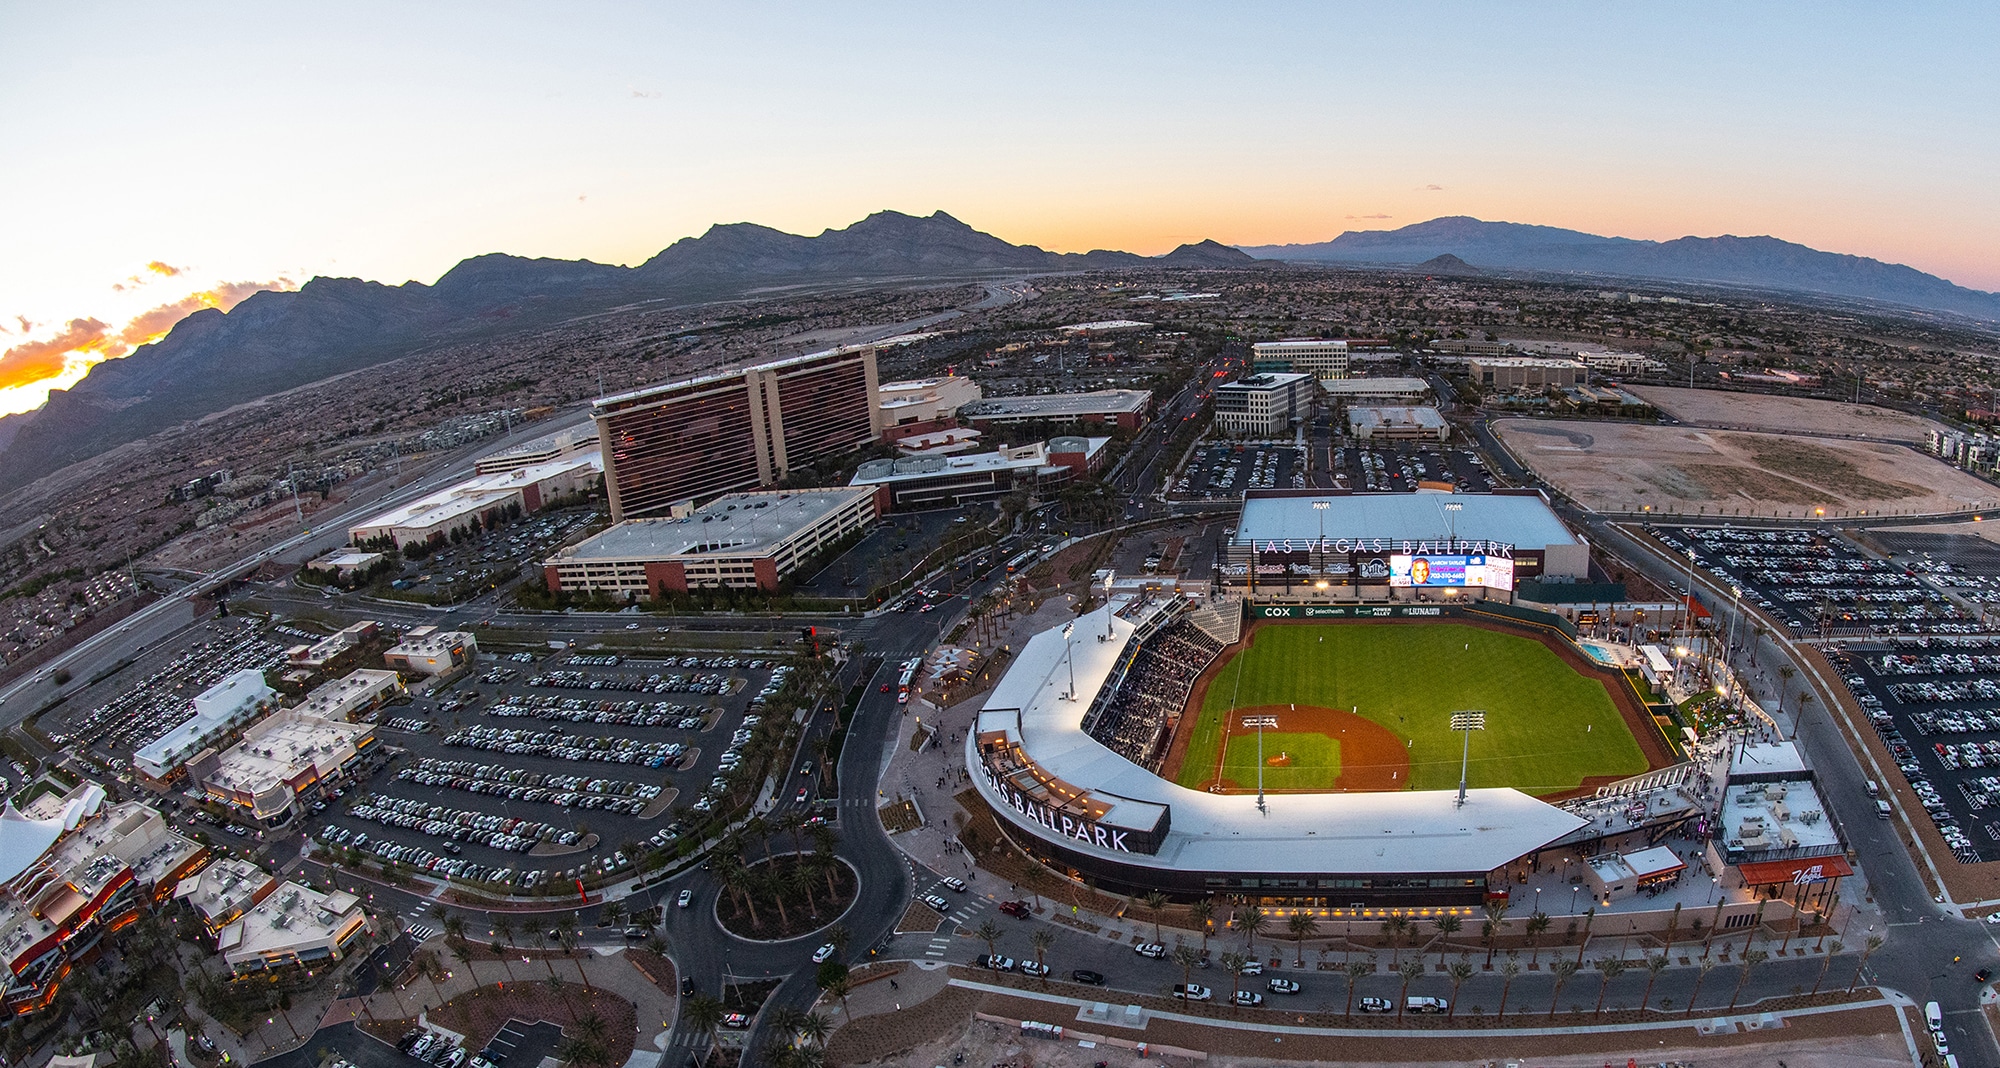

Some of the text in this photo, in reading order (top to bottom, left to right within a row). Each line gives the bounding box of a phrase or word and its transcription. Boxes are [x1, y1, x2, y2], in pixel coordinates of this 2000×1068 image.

[1252, 538, 1513, 559] LAS VEGAS BALLPARK
[1264, 607, 1291, 617] COX
[979, 755, 1130, 853] EGAS BALLPARK
